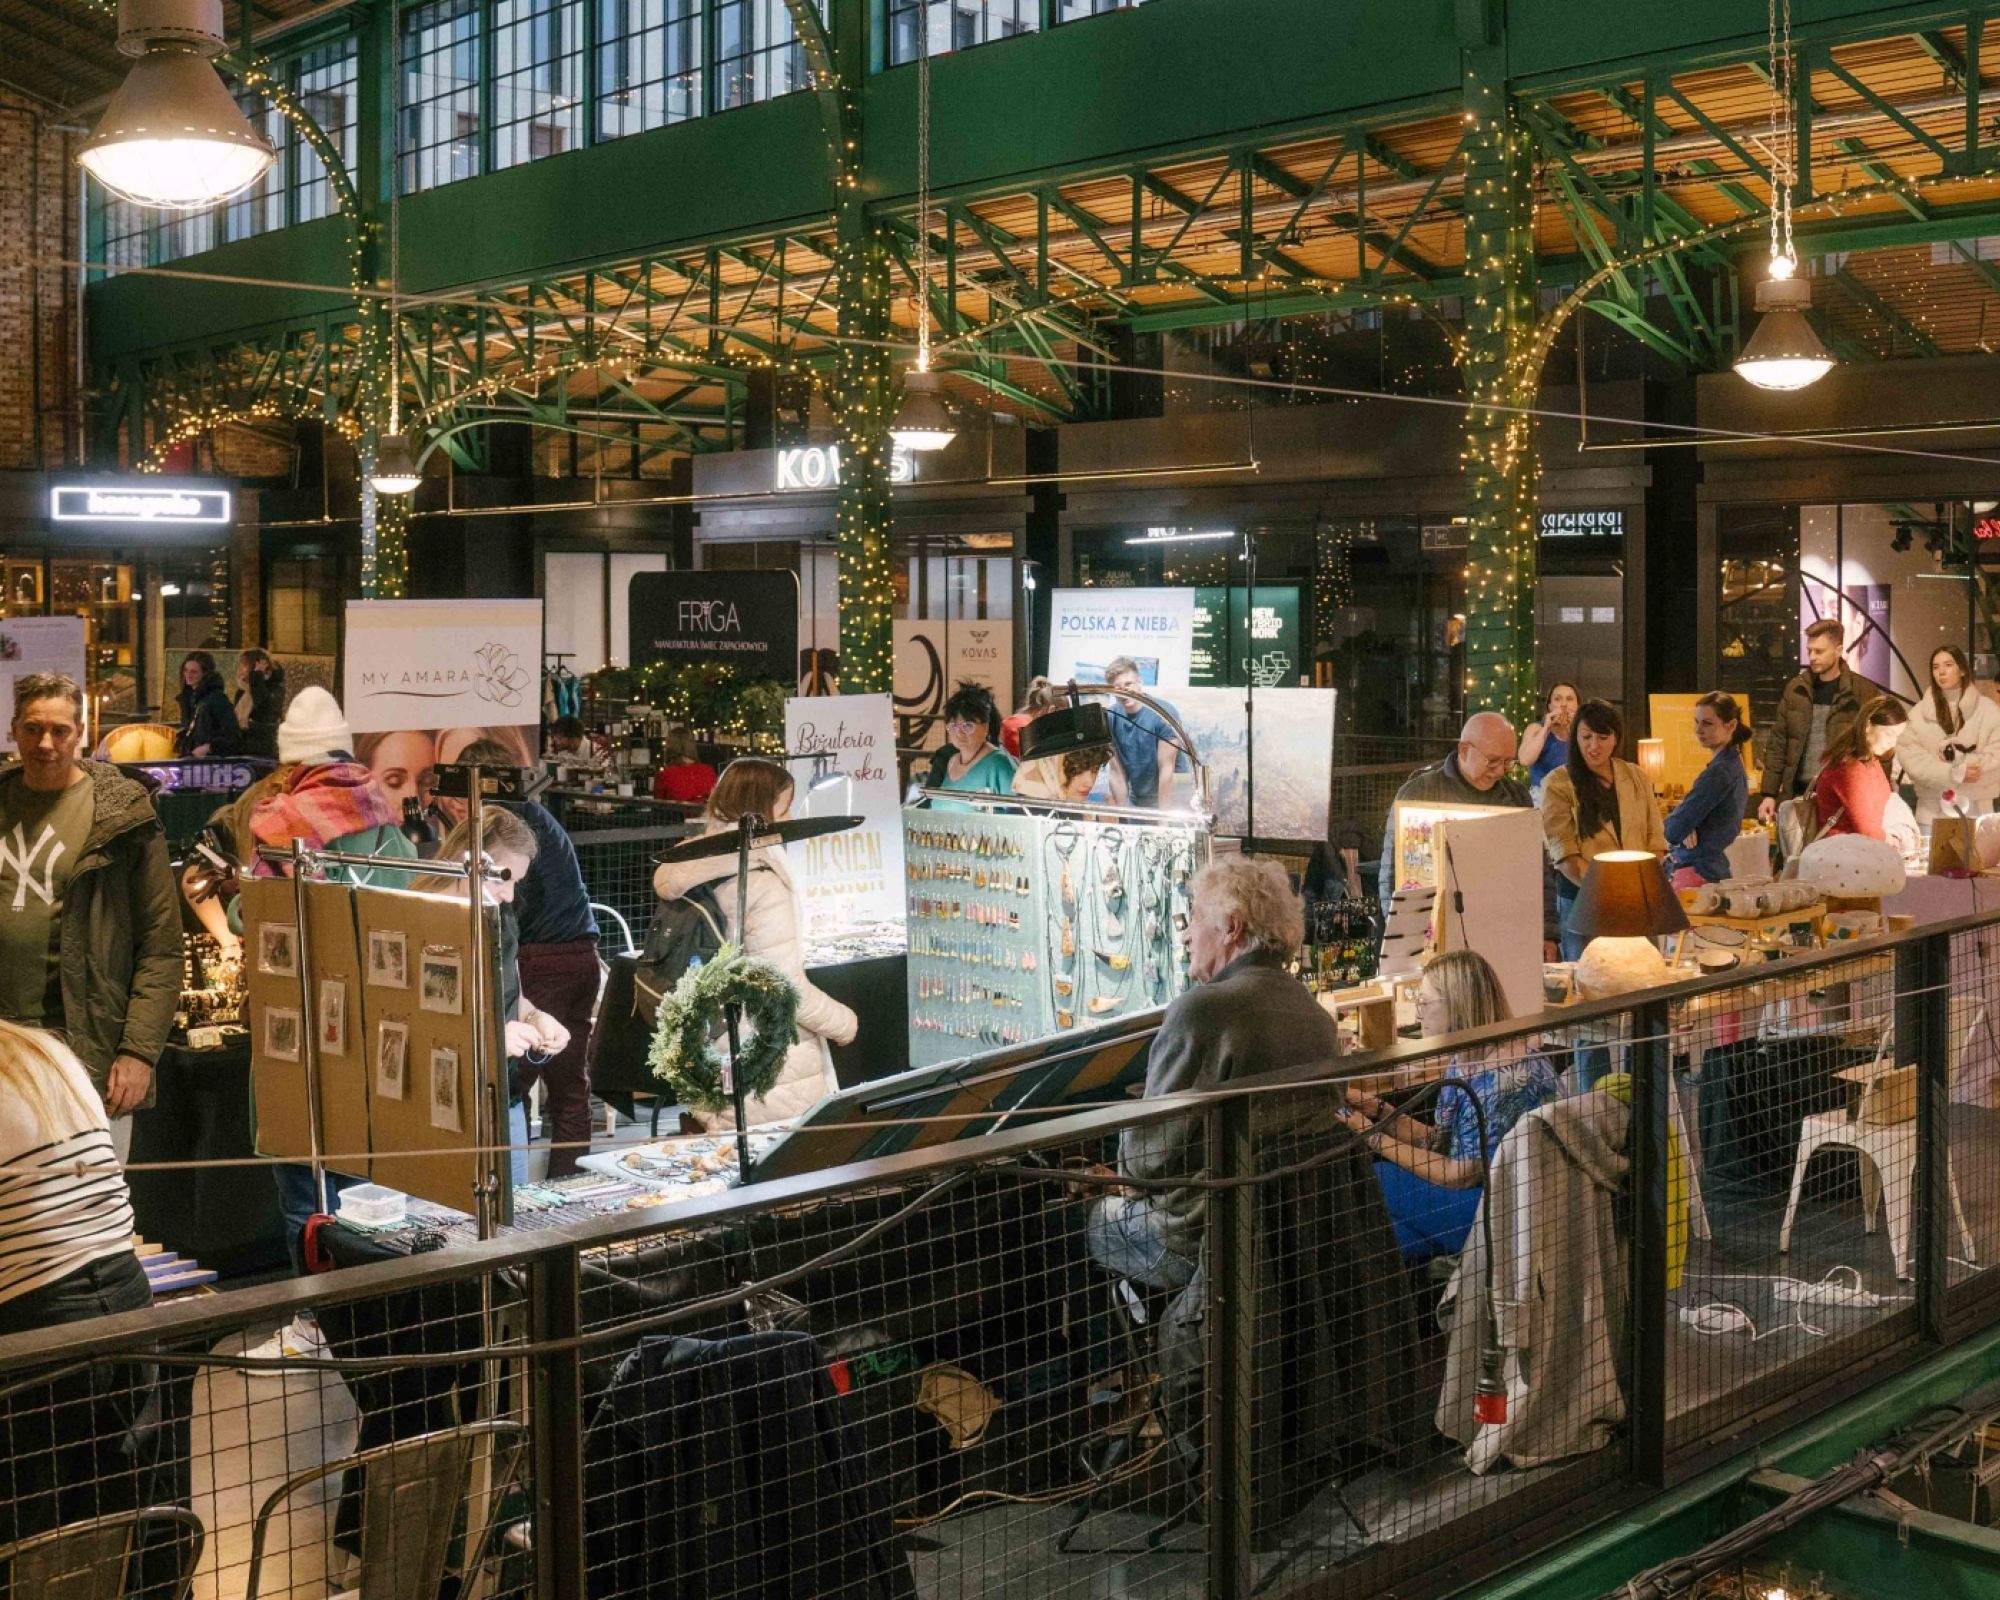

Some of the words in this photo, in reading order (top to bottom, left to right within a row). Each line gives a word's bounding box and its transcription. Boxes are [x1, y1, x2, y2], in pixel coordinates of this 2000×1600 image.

[679, 600, 740, 632] FRIGA
[1061, 616, 1116, 631] POLSKA
[1122, 616, 1129, 631] Z
[1135, 616, 1181, 631] NIEBA
[362, 673, 389, 685] MY
[401, 670, 470, 683] AMARA
